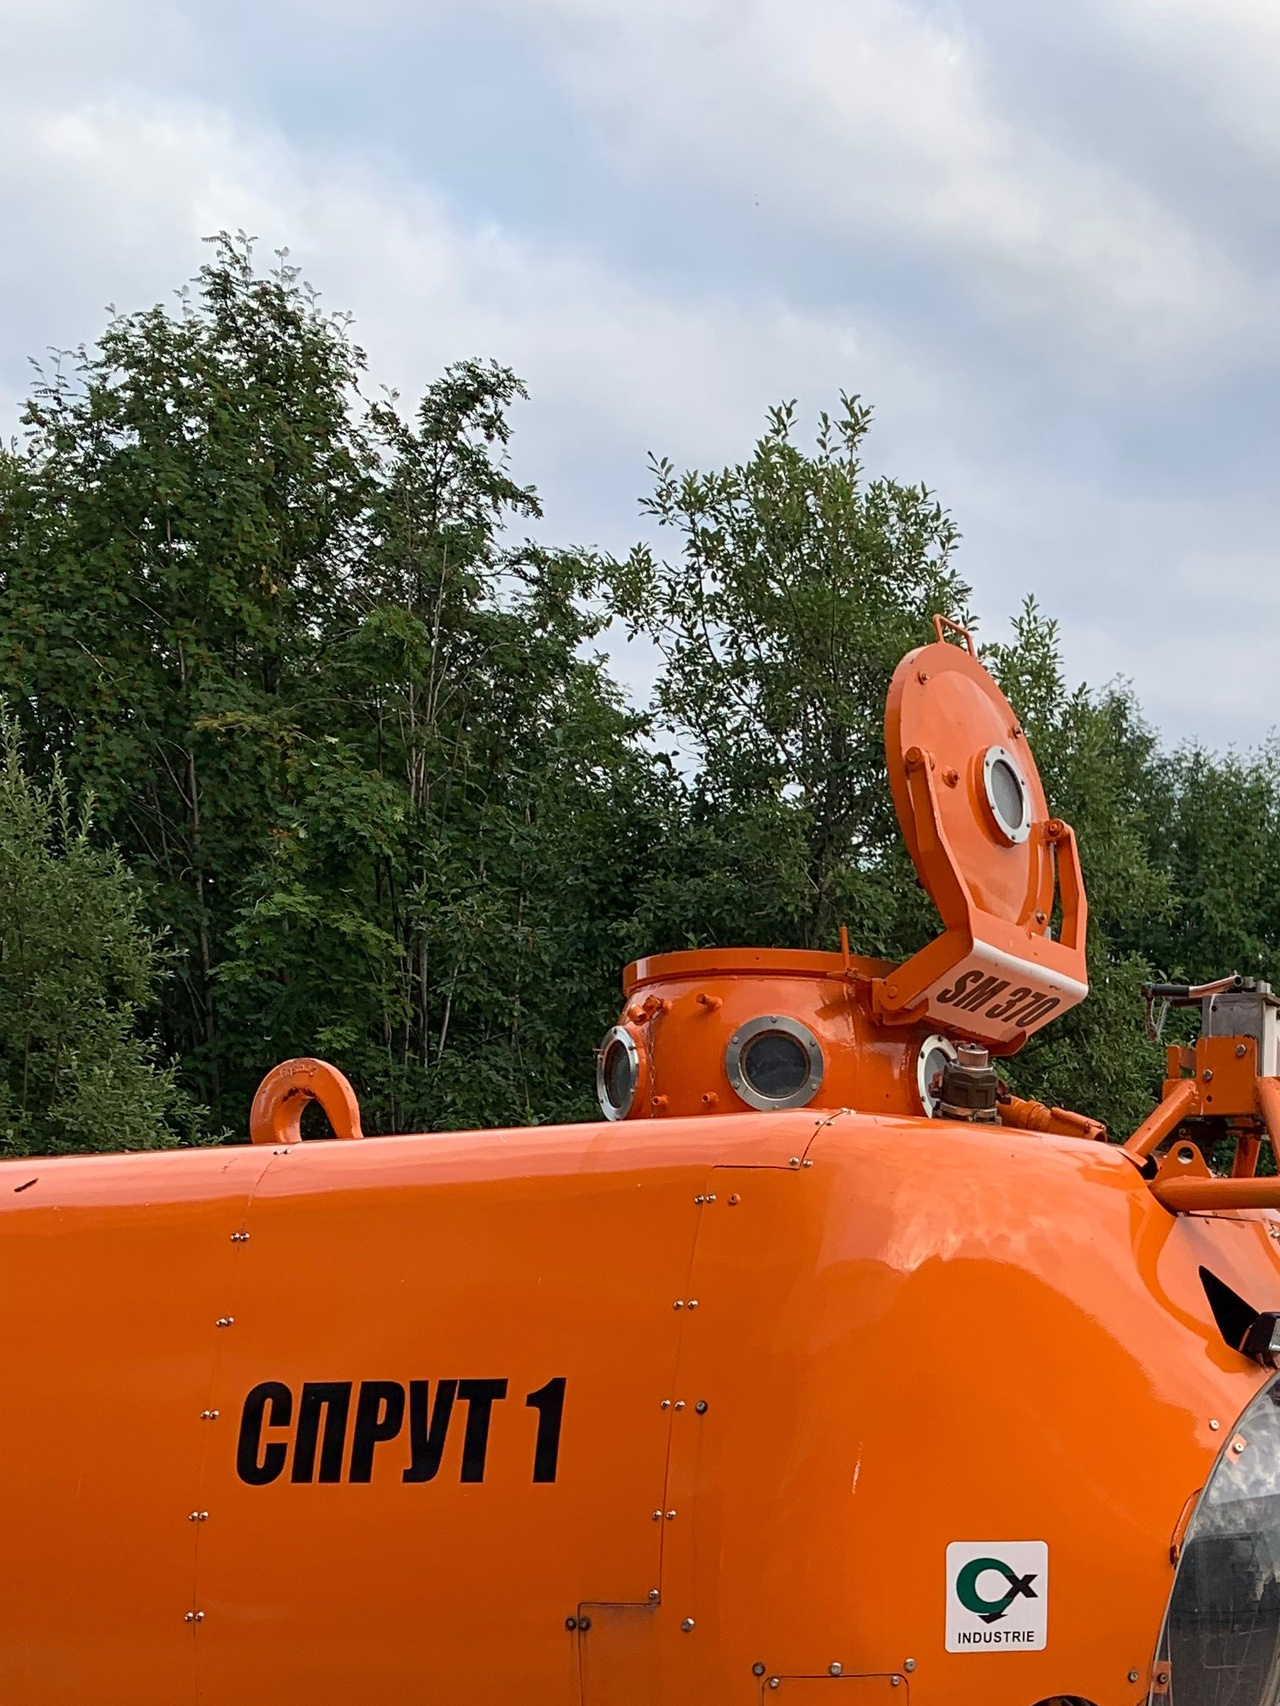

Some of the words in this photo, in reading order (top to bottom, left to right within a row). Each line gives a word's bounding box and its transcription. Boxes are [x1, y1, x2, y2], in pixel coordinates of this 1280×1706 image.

[936, 970, 1012, 1013] SM
[985, 986, 1061, 1028] 370
[236, 1378, 509, 1486] СПРУТ
[525, 1376, 567, 1484] 1
[957, 1630, 1035, 1644] INDUSTRIE
